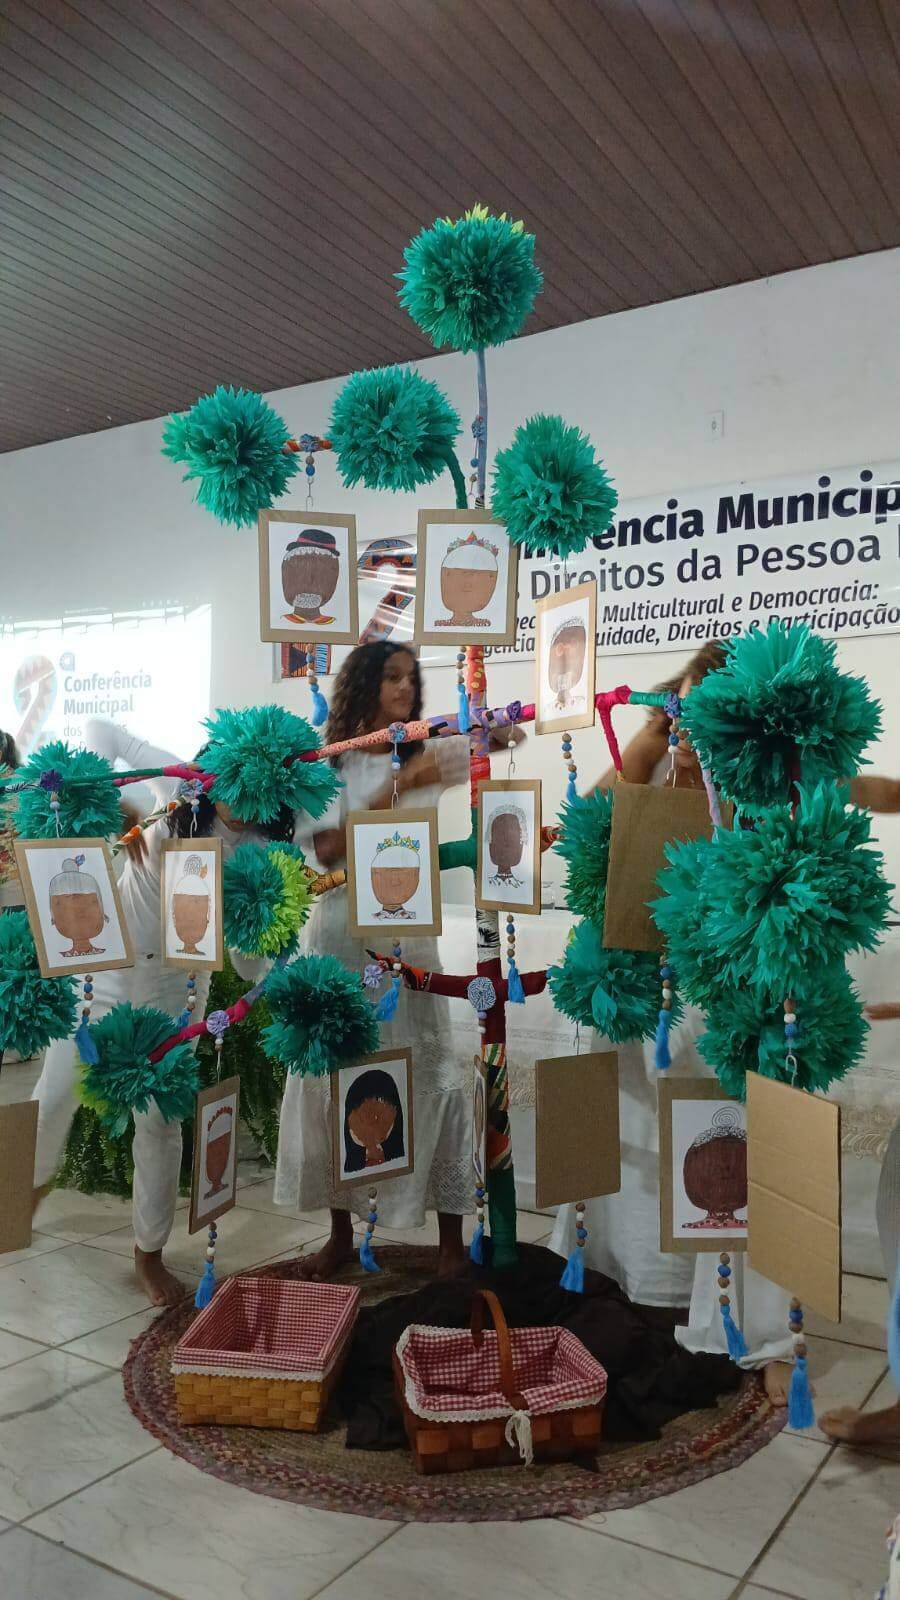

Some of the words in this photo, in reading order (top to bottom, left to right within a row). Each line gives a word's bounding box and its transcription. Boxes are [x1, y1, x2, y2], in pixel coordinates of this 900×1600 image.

[677, 549, 721, 583] da
[737, 535, 880, 576] Pessoa
[603, 594, 724, 623] Multicultural
[732, 597, 742, 611] e
[749, 580, 879, 610] Democracia:
[597, 625, 659, 645] uidade,
[667, 619, 742, 641] Direitos
[64, 670, 152, 692] Conferência
[63, 694, 134, 717] Municipal
[63, 720, 82, 736] dos
